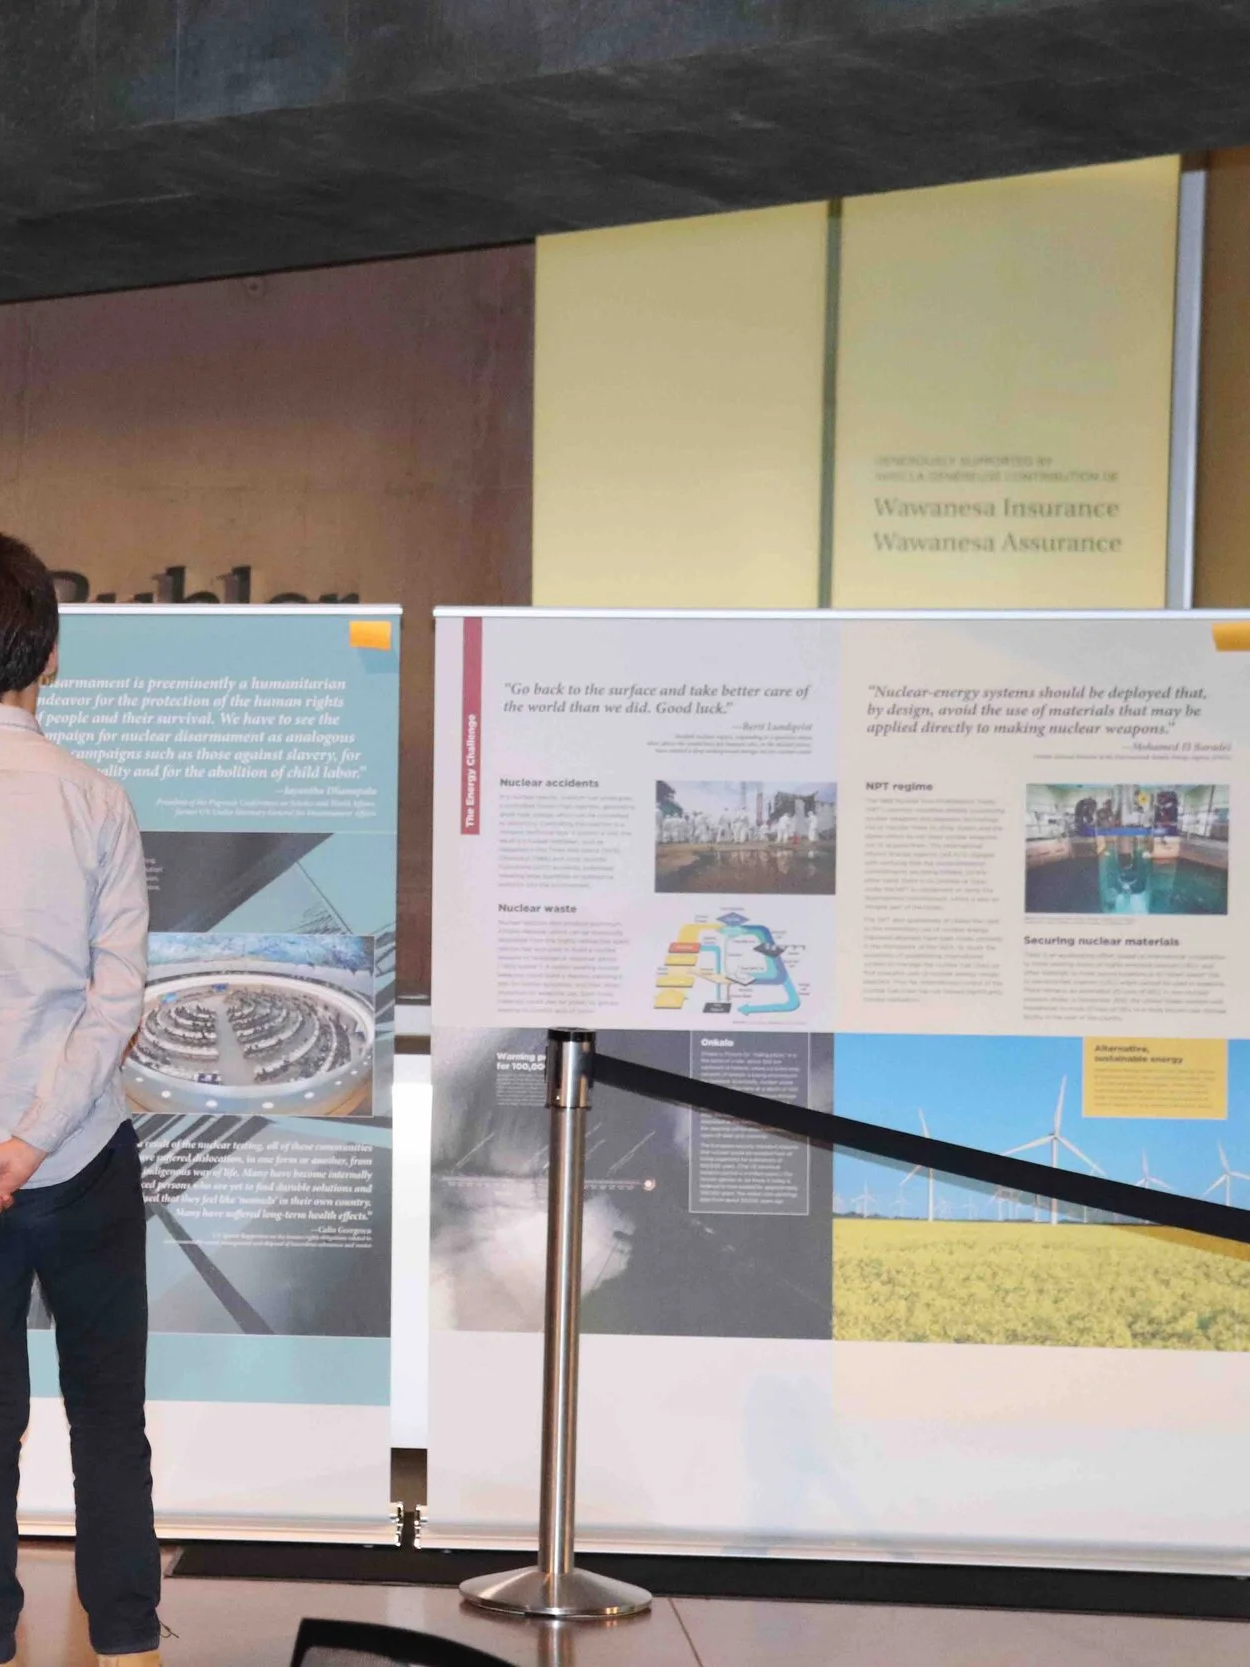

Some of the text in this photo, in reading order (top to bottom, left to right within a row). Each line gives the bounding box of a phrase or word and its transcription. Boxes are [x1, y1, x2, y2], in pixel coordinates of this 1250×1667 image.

[874, 495, 1119, 519] Wawanesa Insurance
[874, 530, 1122, 552] Wawanesa Assurance
[533, 682, 565, 695] back
[567, 682, 582, 695] to
[584, 682, 606, 696] the
[607, 682, 657, 700] surface
[658, 683, 687, 696] and
[689, 683, 719, 696] take
[720, 683, 761, 697] better
[763, 688, 793, 697] care
[795, 684, 810, 701] of
[982, 684, 1036, 702] systems
[1038, 685, 1086, 698] should
[1088, 685, 1105, 699] be
[1107, 685, 1172, 703] deployed
[1174, 686, 1207, 703] that,
[37, 693, 345, 711] ndeavor for the protection of the human rights
[464, 714, 479, 827] The Energy Challenge
[499, 776, 599, 788] Nuclear accidents
[865, 780, 934, 793] NPT regime
[497, 902, 577, 913] Nuclear waste
[1023, 935, 1180, 947] Securing nuclear materials
[701, 1036, 733, 1047] Onkalo
[496, 1052, 536, 1062] Warning
[1094, 1053, 1183, 1065] sustainable energy
[496, 1062, 546, 1071] for 100,00
